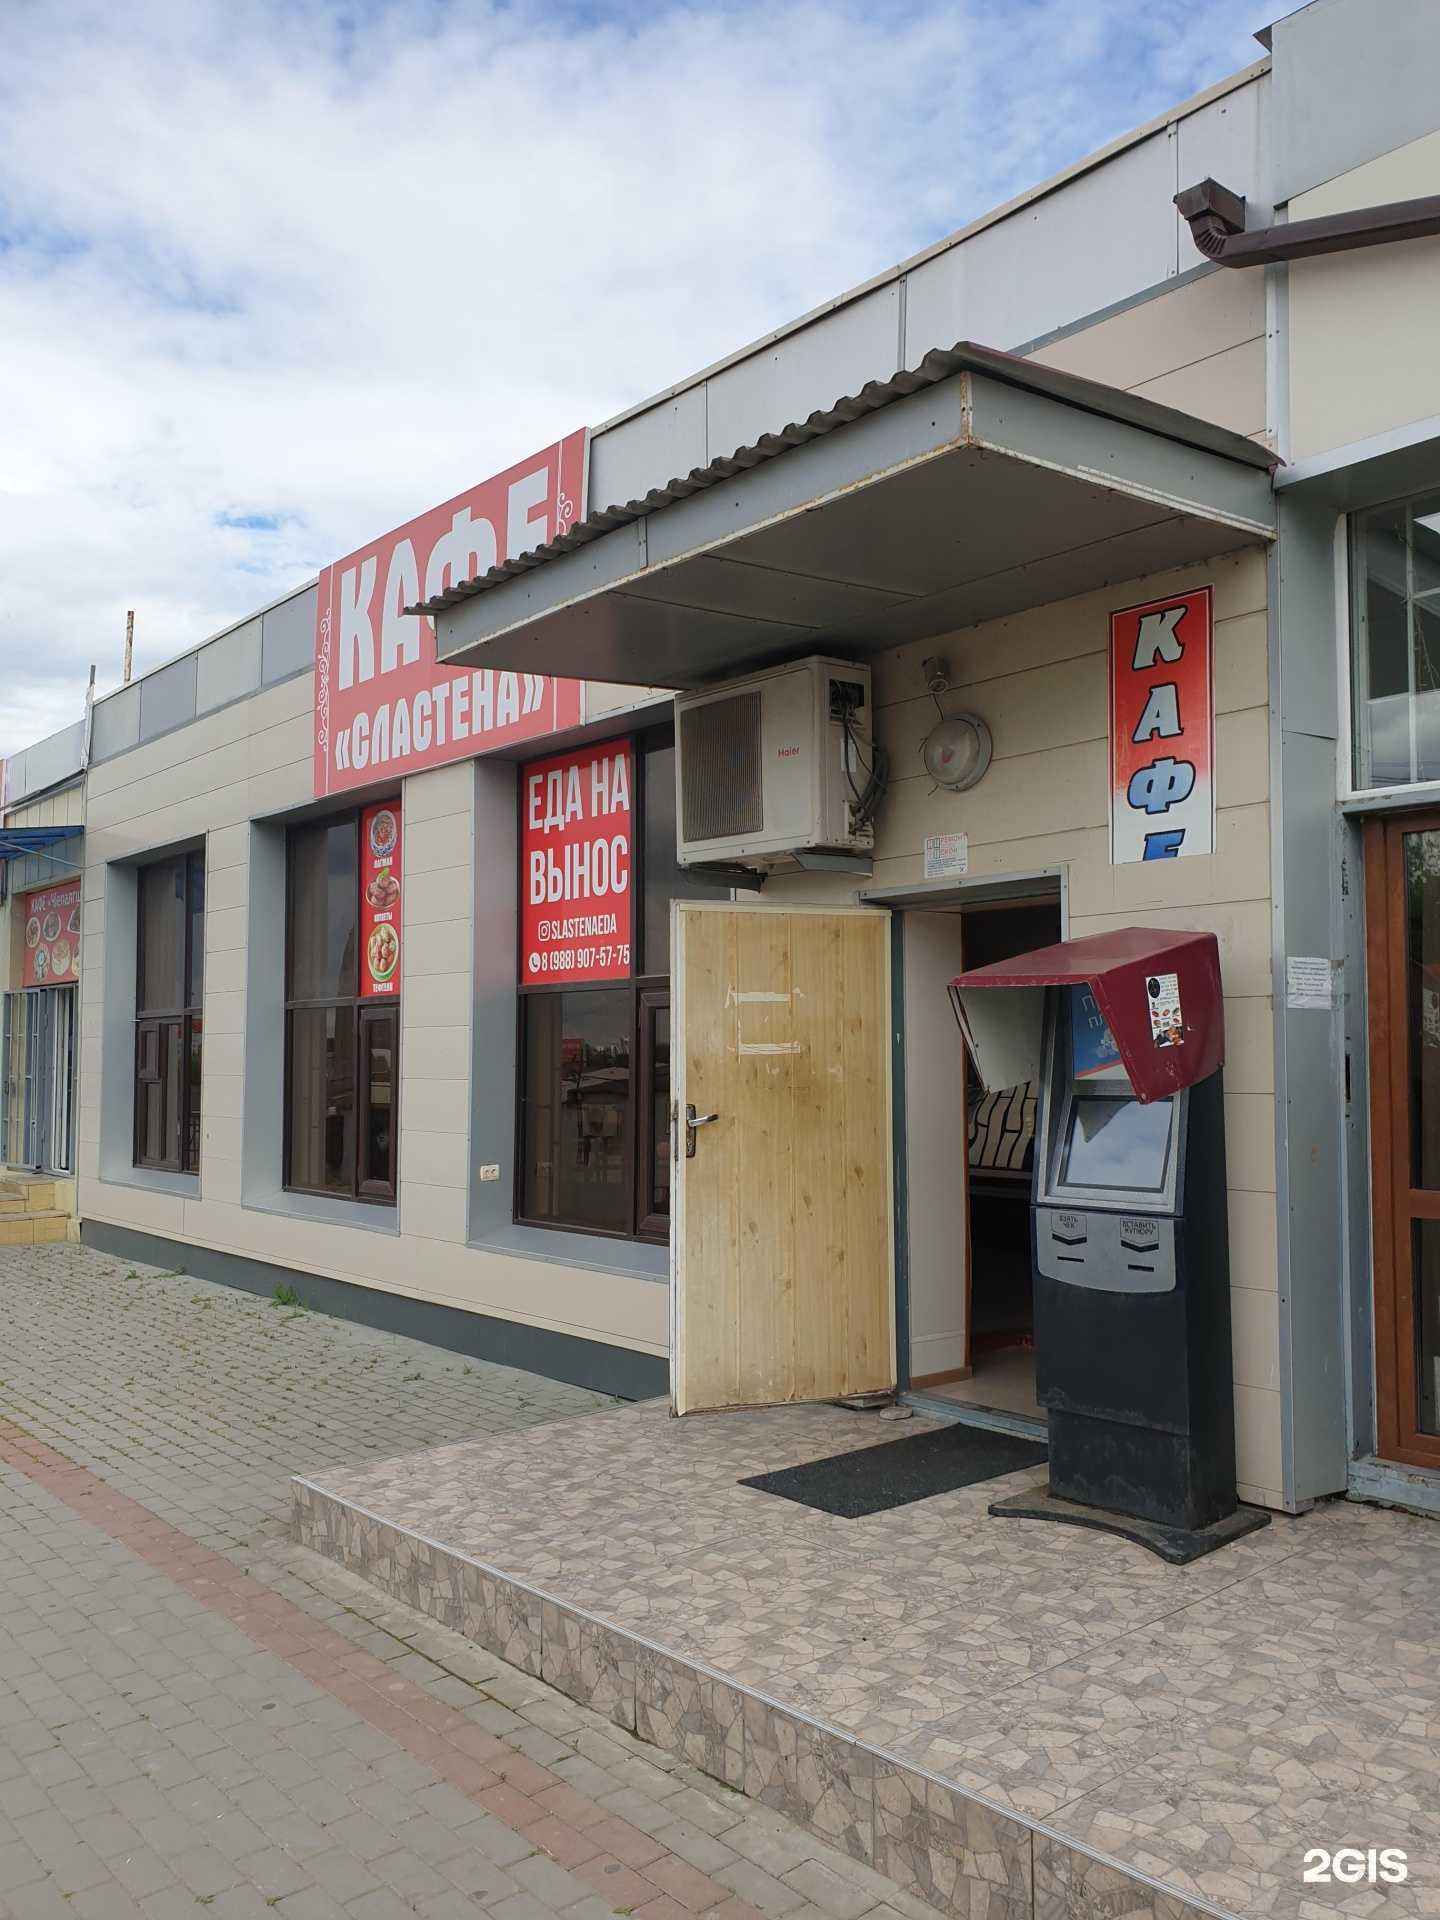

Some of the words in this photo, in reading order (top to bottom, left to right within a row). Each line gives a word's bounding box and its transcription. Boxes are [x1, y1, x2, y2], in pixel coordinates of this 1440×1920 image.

[335, 669, 545, 771] «СЛАСТЕНА»
[777, 746, 800, 759] Haier
[528, 765, 584, 835] ЕДА
[591, 753, 631, 818] НА
[530, 835, 628, 906] ВЫНОС
[550, 913, 617, 941] SLASTENAEDA
[541, 954, 549, 972] 8
[549, 950, 575, 971] (988)
[577, 944, 631, 969] 907-57-75
